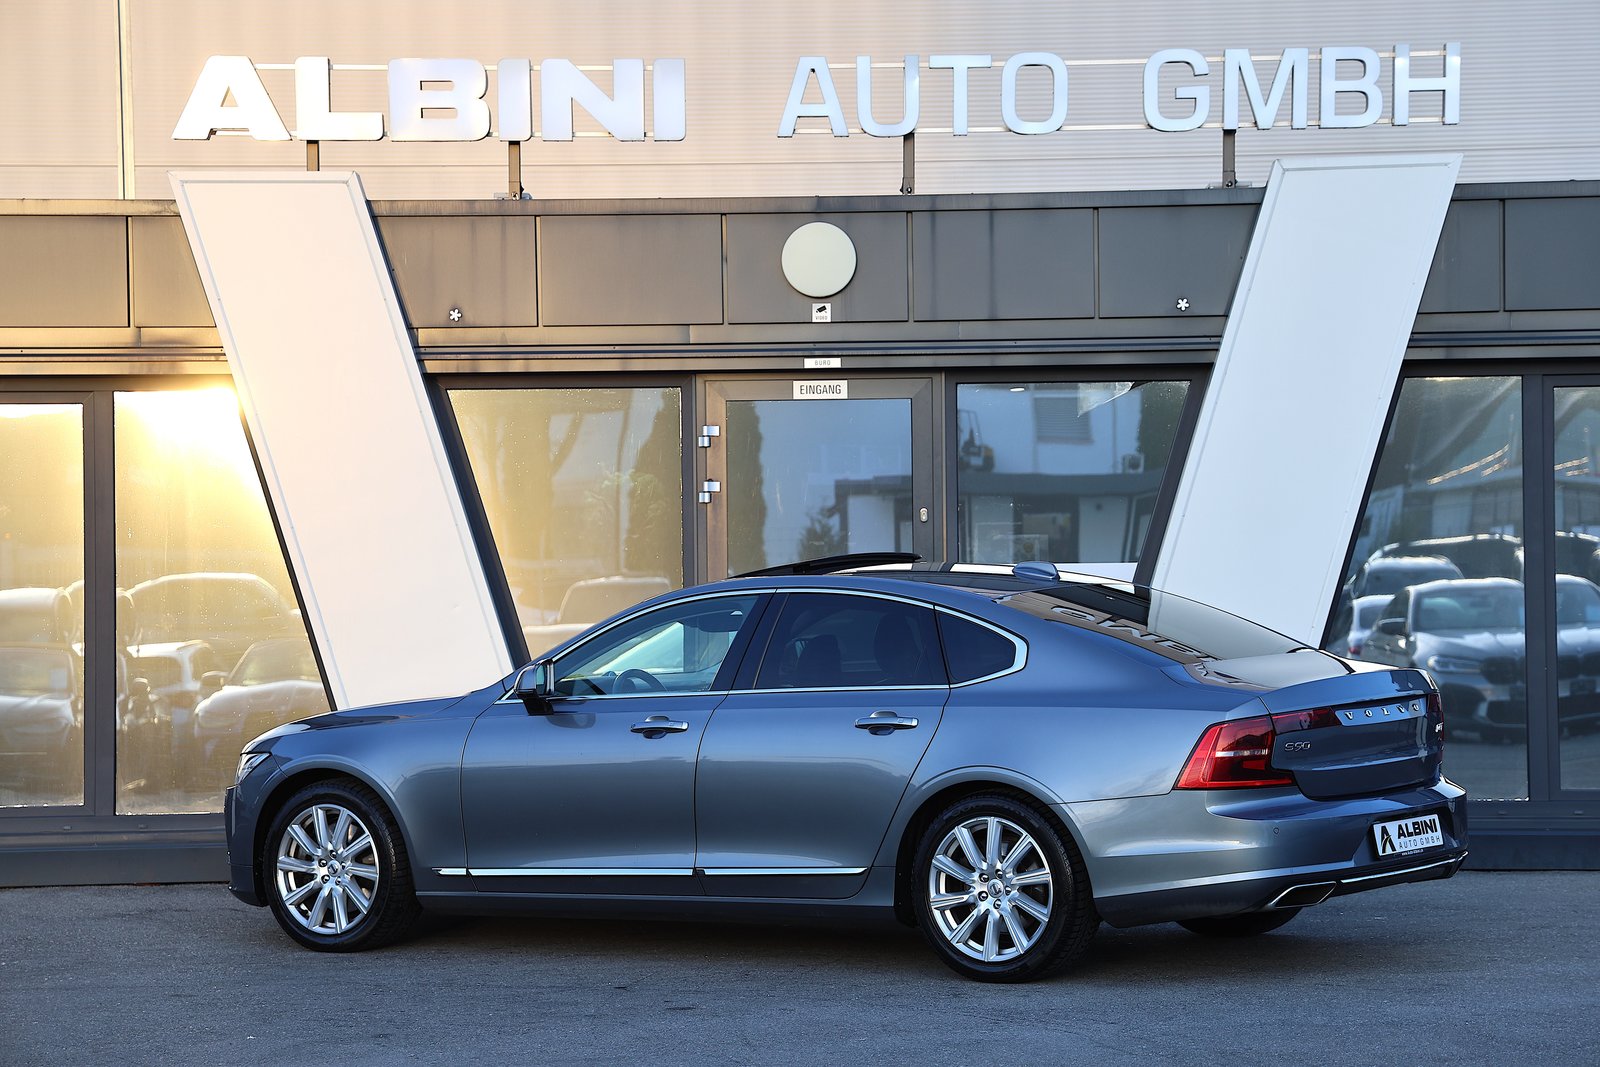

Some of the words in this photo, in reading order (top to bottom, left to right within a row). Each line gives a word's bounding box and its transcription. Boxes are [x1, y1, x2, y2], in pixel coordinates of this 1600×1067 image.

[171, 55, 686, 142] ALBINI
[777, 51, 1069, 138] AUTO
[1143, 42, 1462, 132] GMBH
[799, 384, 842, 395] EINGANG
[1344, 703, 1420, 720] VOLVO
[1284, 741, 1311, 751] S90
[1397, 818, 1438, 839] ALBINI
[1399, 838, 1418, 849] AUTO
[1420, 835, 1441, 846] GMBH
